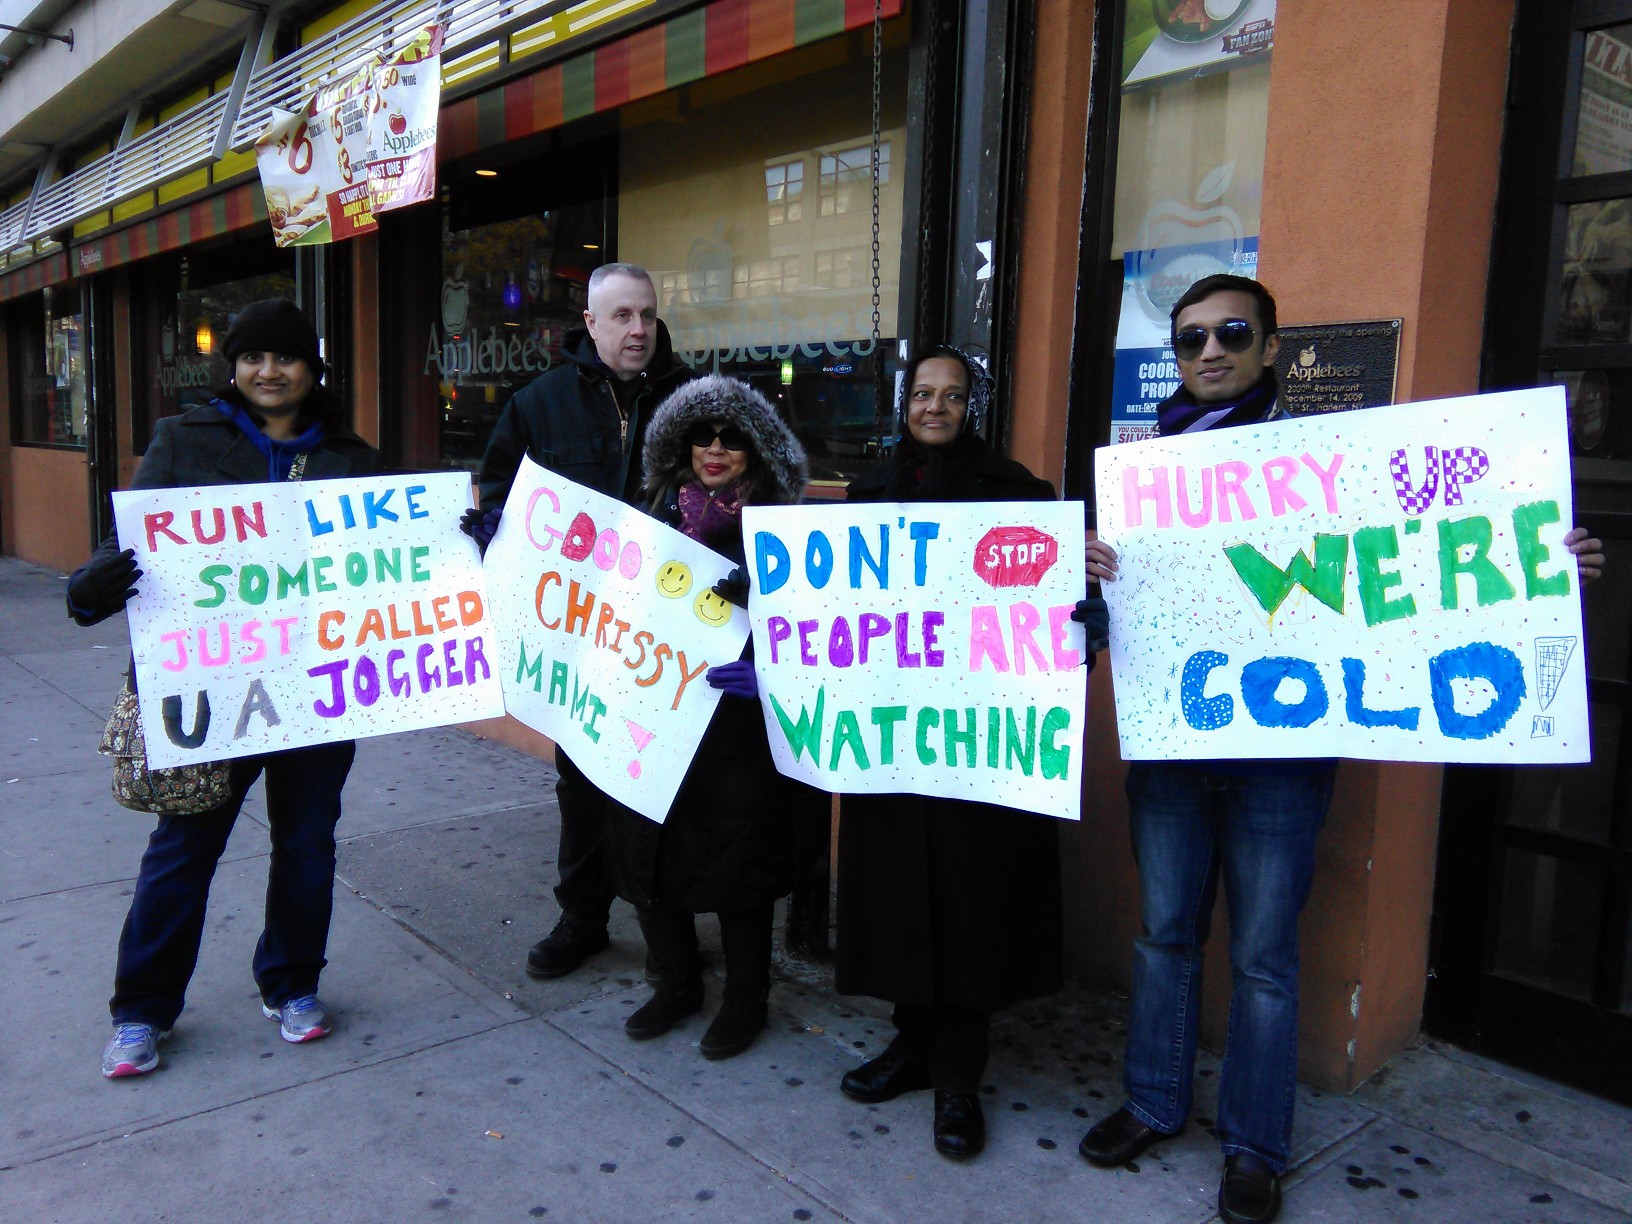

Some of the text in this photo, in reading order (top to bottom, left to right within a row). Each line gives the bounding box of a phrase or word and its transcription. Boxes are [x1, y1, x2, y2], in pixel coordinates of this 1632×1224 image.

[385, 160, 402, 176] ONE
[1343, 392, 1364, 402] 2009
[144, 485, 429, 552] RUN LIKE
[1122, 445, 1490, 529] HURRY UP
[193, 546, 430, 608] SOMEONE
[754, 517, 1046, 595] DON'T STOP
[1222, 500, 1572, 628] WE'RE
[160, 590, 484, 672] JUST CALLED
[535, 571, 709, 711] CHRISSY
[767, 601, 1081, 676] PEOPLE ARE
[162, 636, 491, 750] U A JOGGER
[769, 684, 1071, 781] WATCHING
